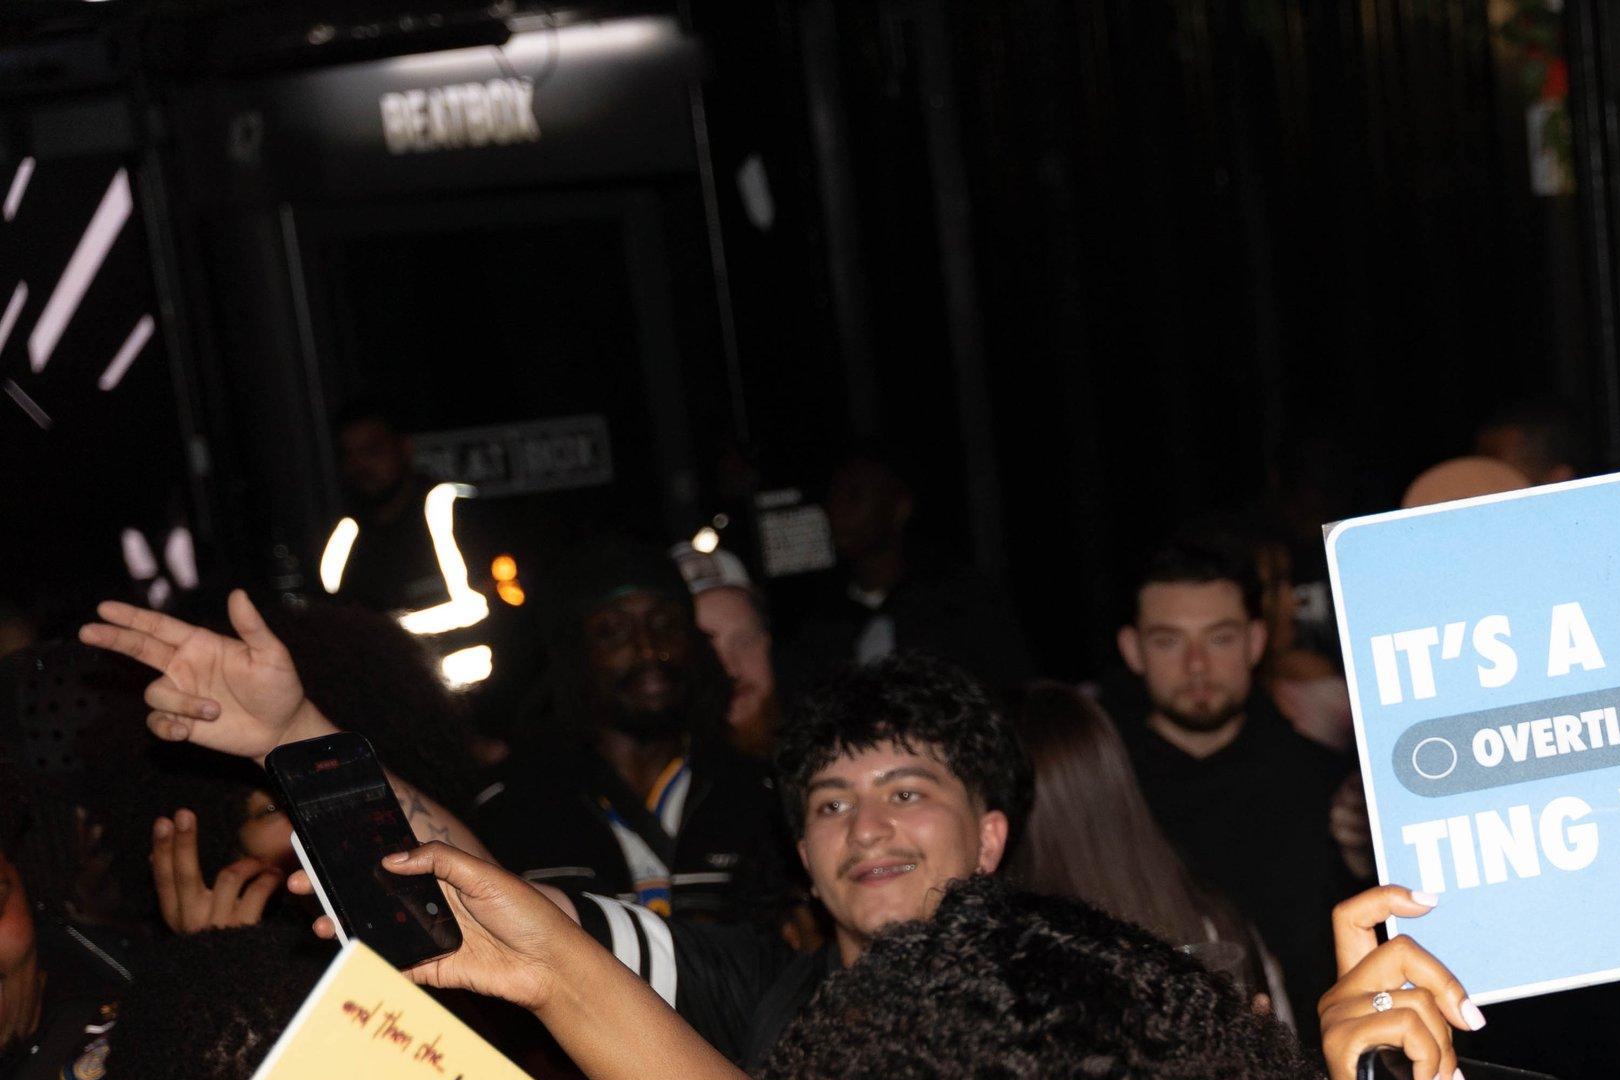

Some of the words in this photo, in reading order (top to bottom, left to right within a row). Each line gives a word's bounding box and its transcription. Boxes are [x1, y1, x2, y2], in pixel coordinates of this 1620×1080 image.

[379, 78, 542, 154] BEATBOX
[1370, 614, 1518, 706] IT'S
[1546, 601, 1606, 677] A
[1402, 796, 1600, 894] TING
